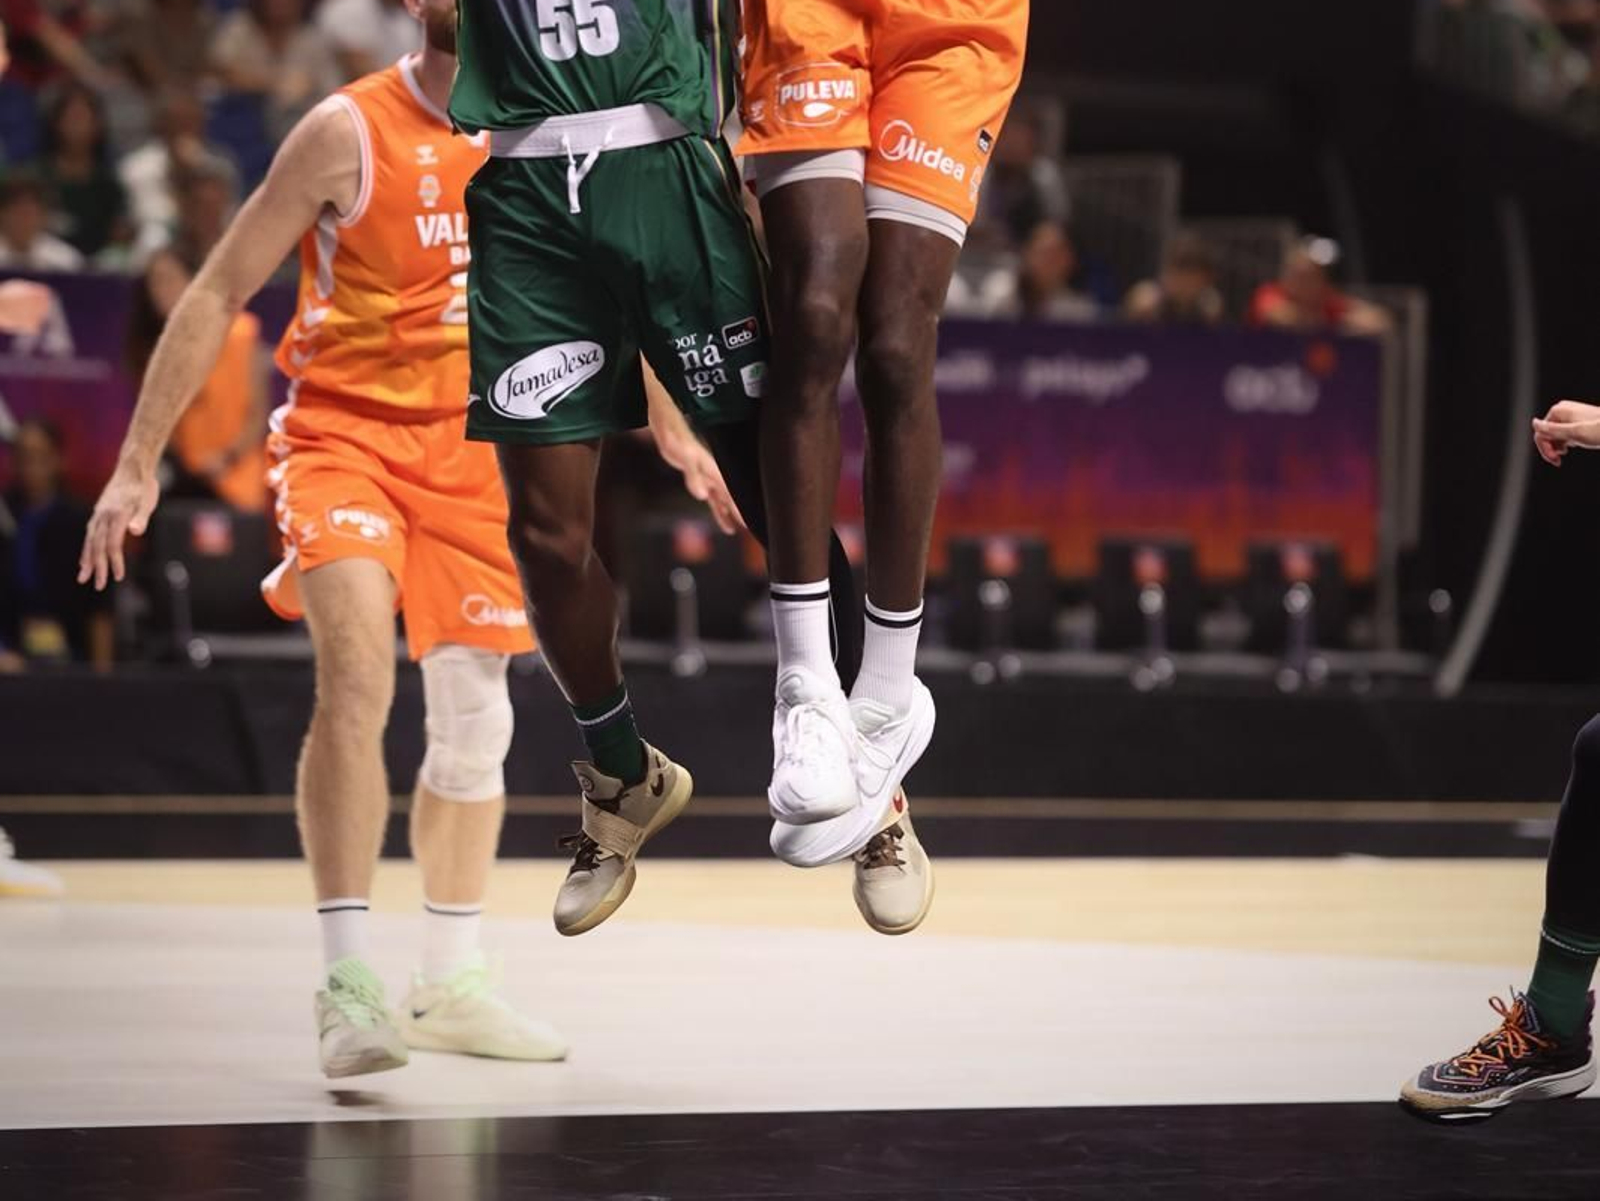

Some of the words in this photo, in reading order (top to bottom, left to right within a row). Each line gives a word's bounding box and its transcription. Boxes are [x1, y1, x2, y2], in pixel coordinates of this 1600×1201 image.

[780, 79, 856, 104] PULEVA
[890, 132, 966, 183] Midea
[728, 328, 753, 346] acb
[502, 348, 600, 408] famadesa
